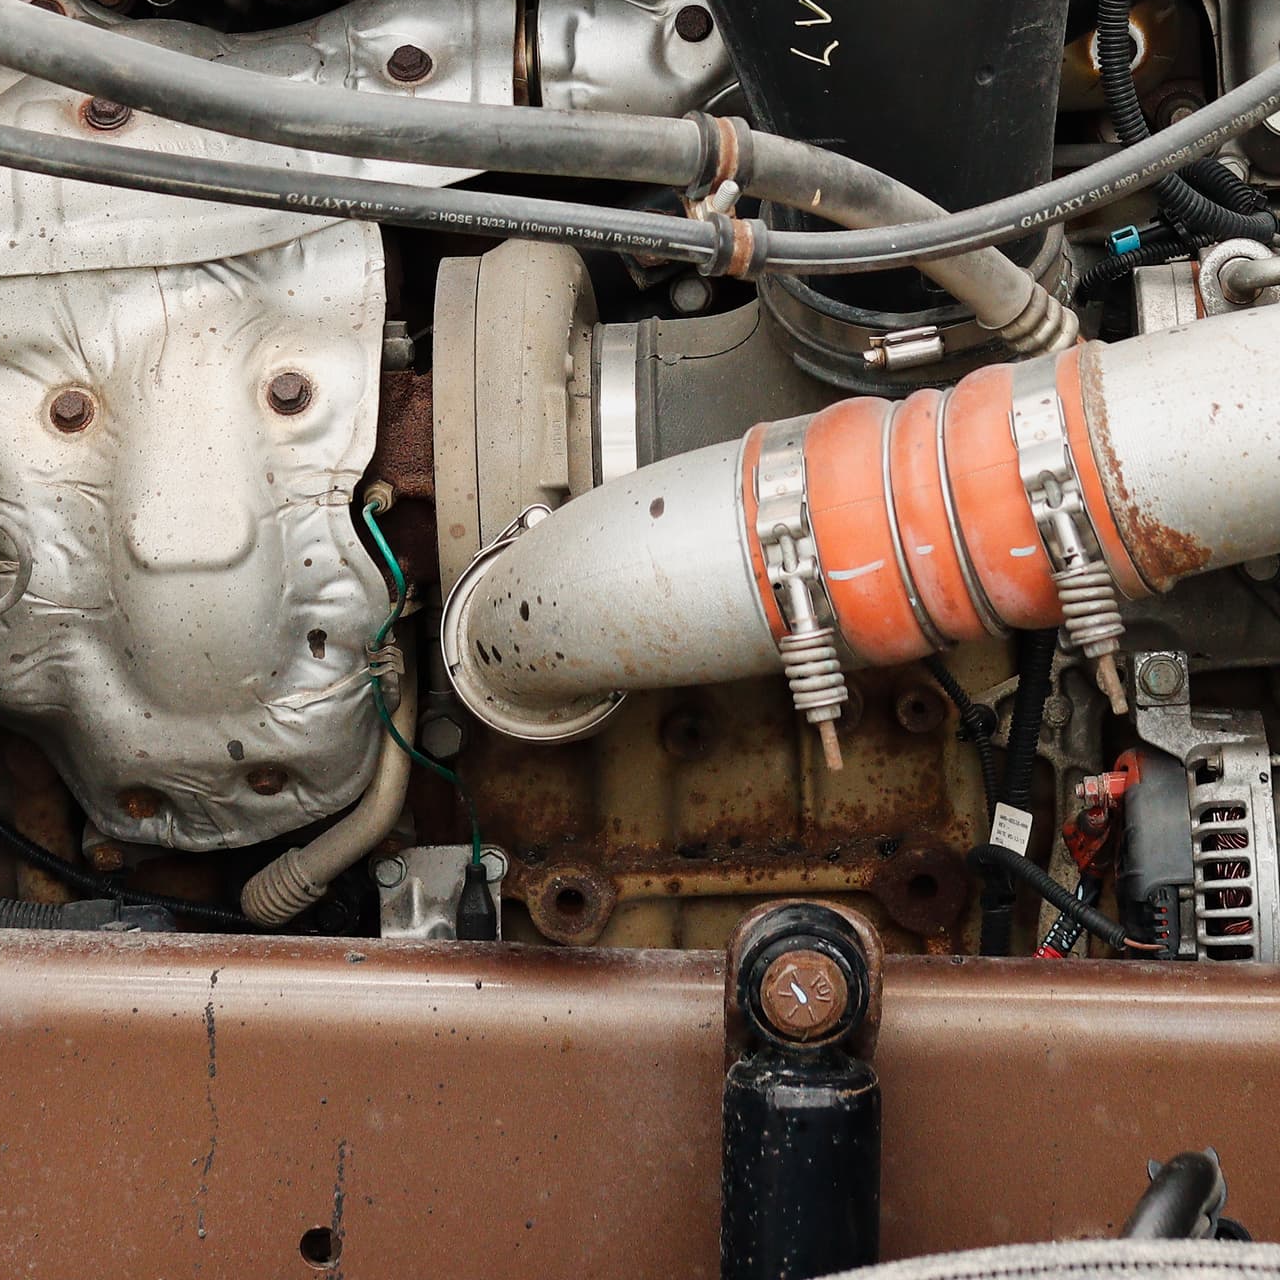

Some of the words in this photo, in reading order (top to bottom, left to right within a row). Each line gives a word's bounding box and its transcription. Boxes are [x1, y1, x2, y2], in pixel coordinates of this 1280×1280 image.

[286, 191, 358, 212] GALAXY
[439, 210, 474, 226] HOSE
[475, 215, 507, 230] 13/32
[520, 220, 563, 237] (10mm)
[565, 226, 605, 242] R-134a
[613, 233, 663, 250] R-1234yf
[1021, 195, 1087, 228] GALAXY
[1160, 146, 1192, 172] HOSE
